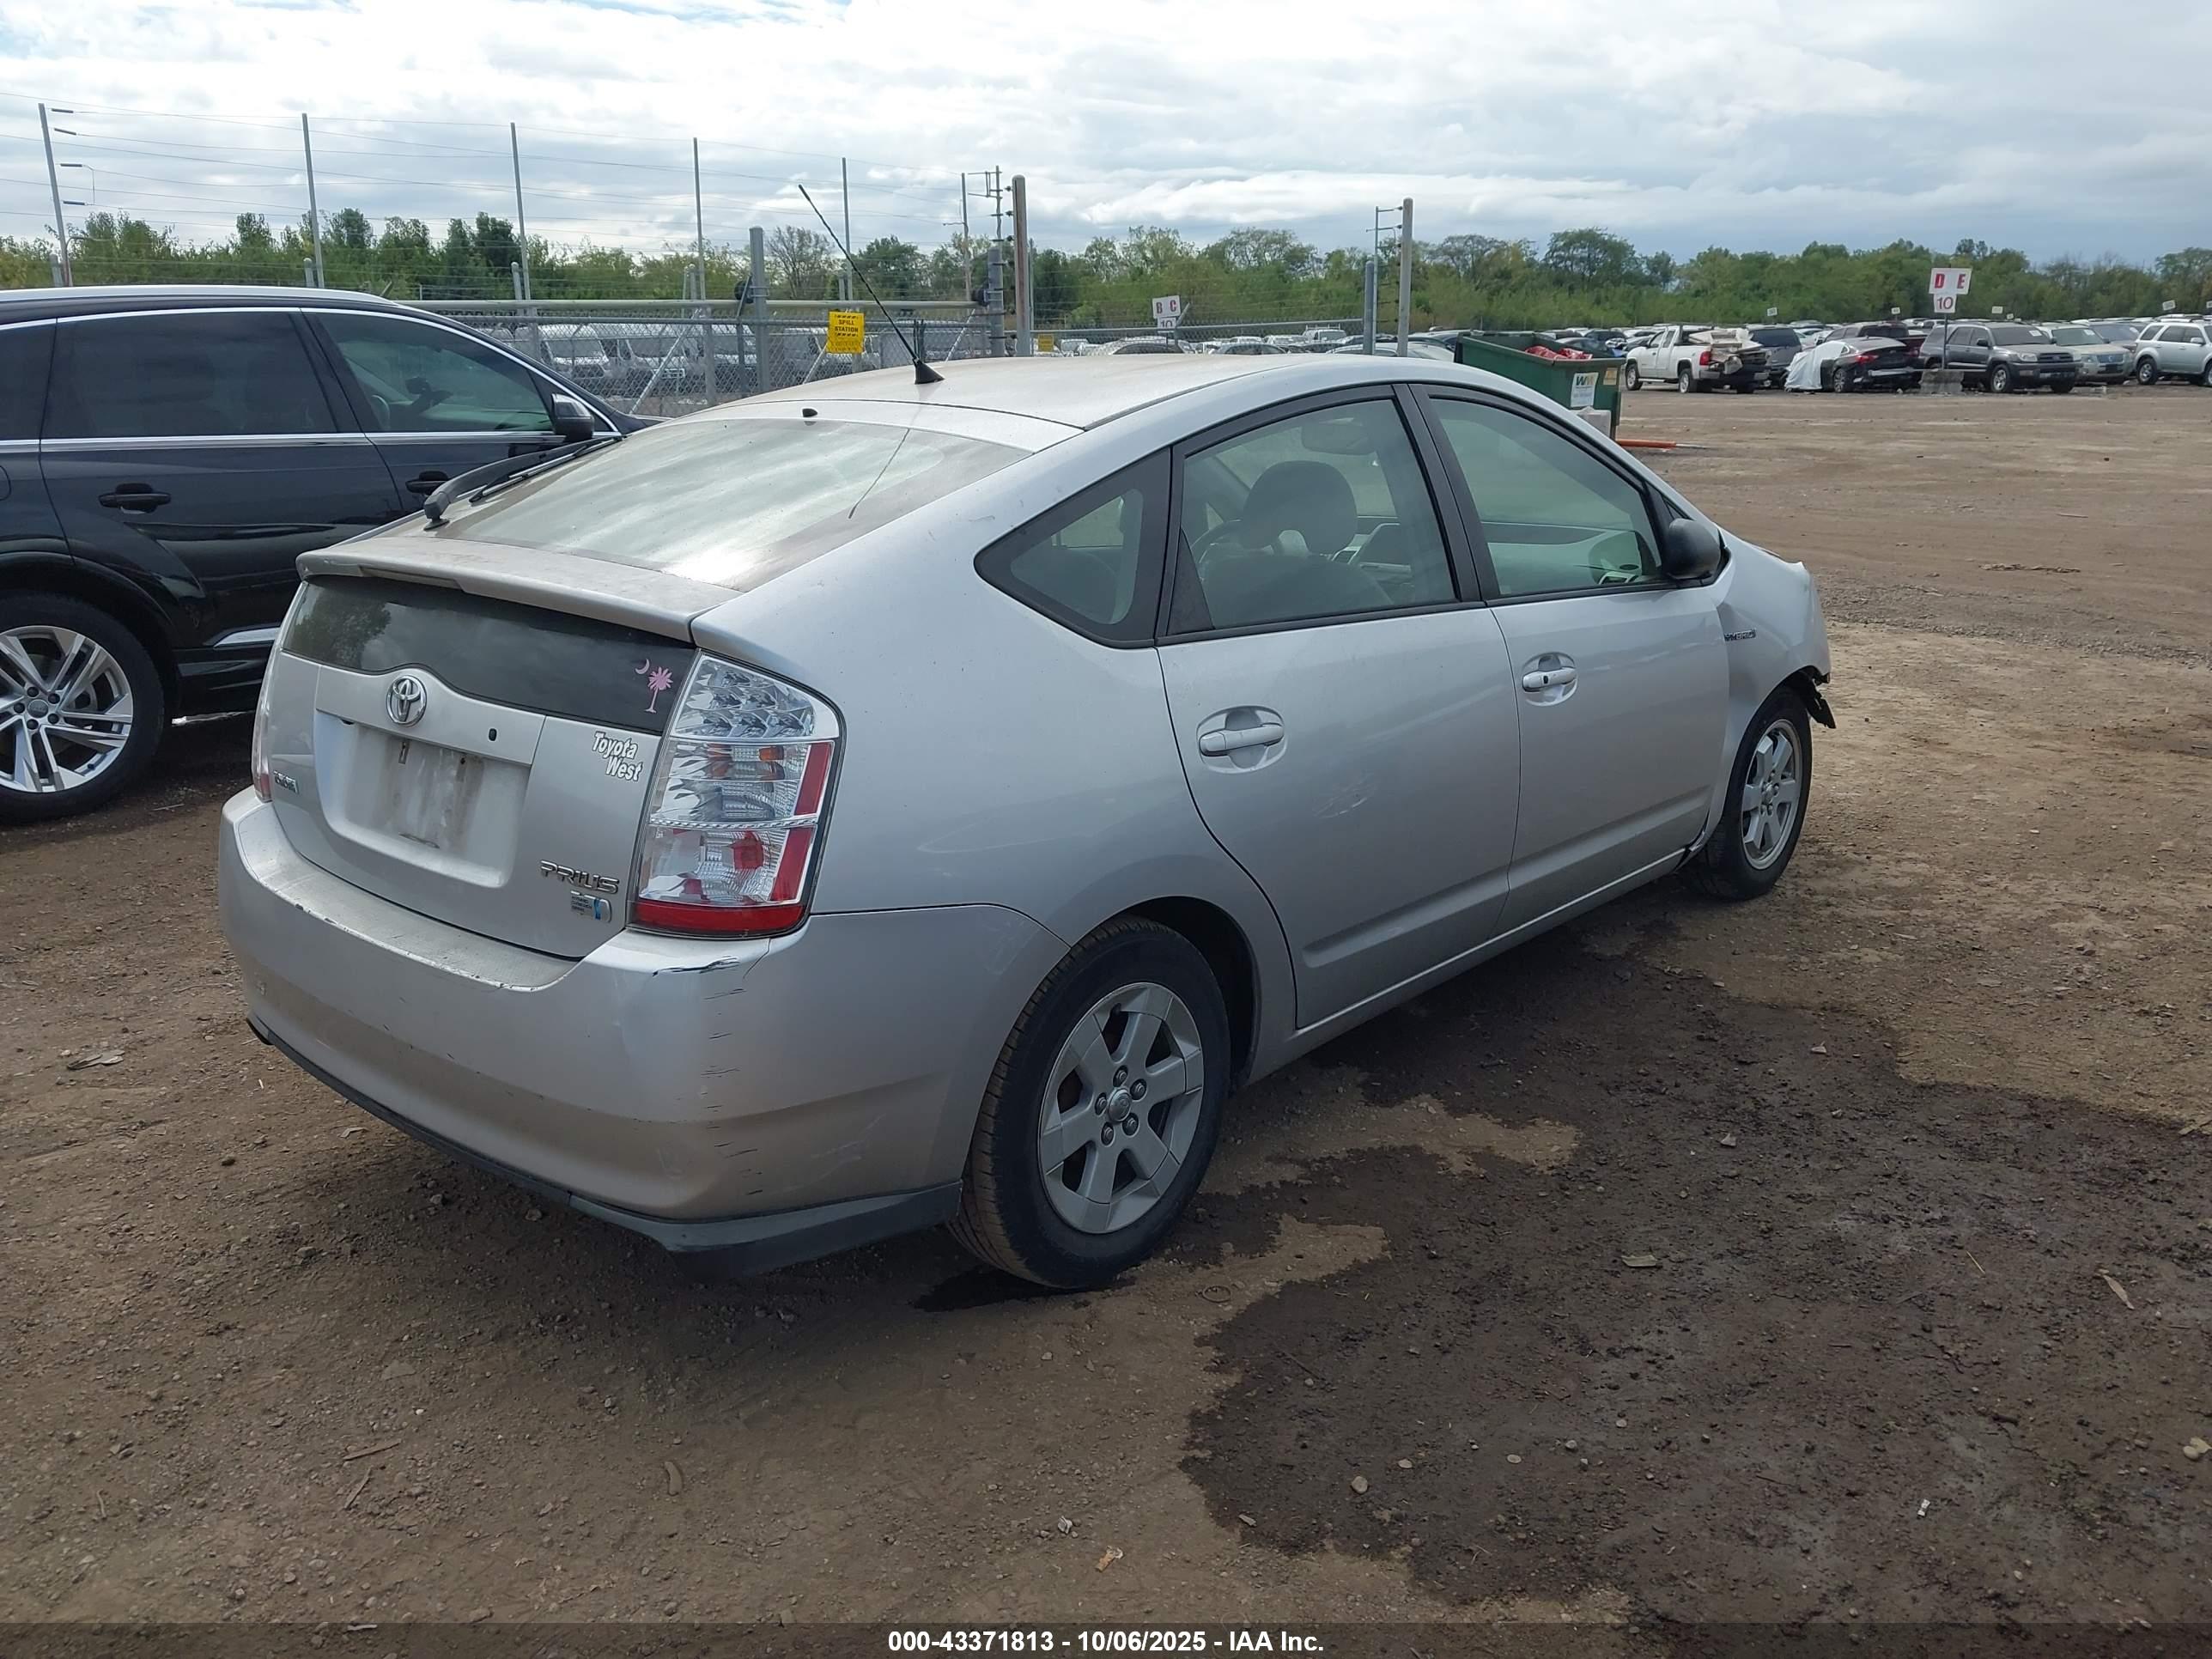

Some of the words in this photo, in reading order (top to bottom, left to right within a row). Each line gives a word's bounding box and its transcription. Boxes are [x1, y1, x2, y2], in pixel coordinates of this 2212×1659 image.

[1934, 273, 1946, 289] D
[1956, 273, 1966, 289] E
[1170, 299, 1176, 313] C
[1937, 296, 1954, 310] 10
[592, 730, 639, 760] Toyota
[605, 755, 643, 782] West
[540, 860, 620, 895] PRIUS
